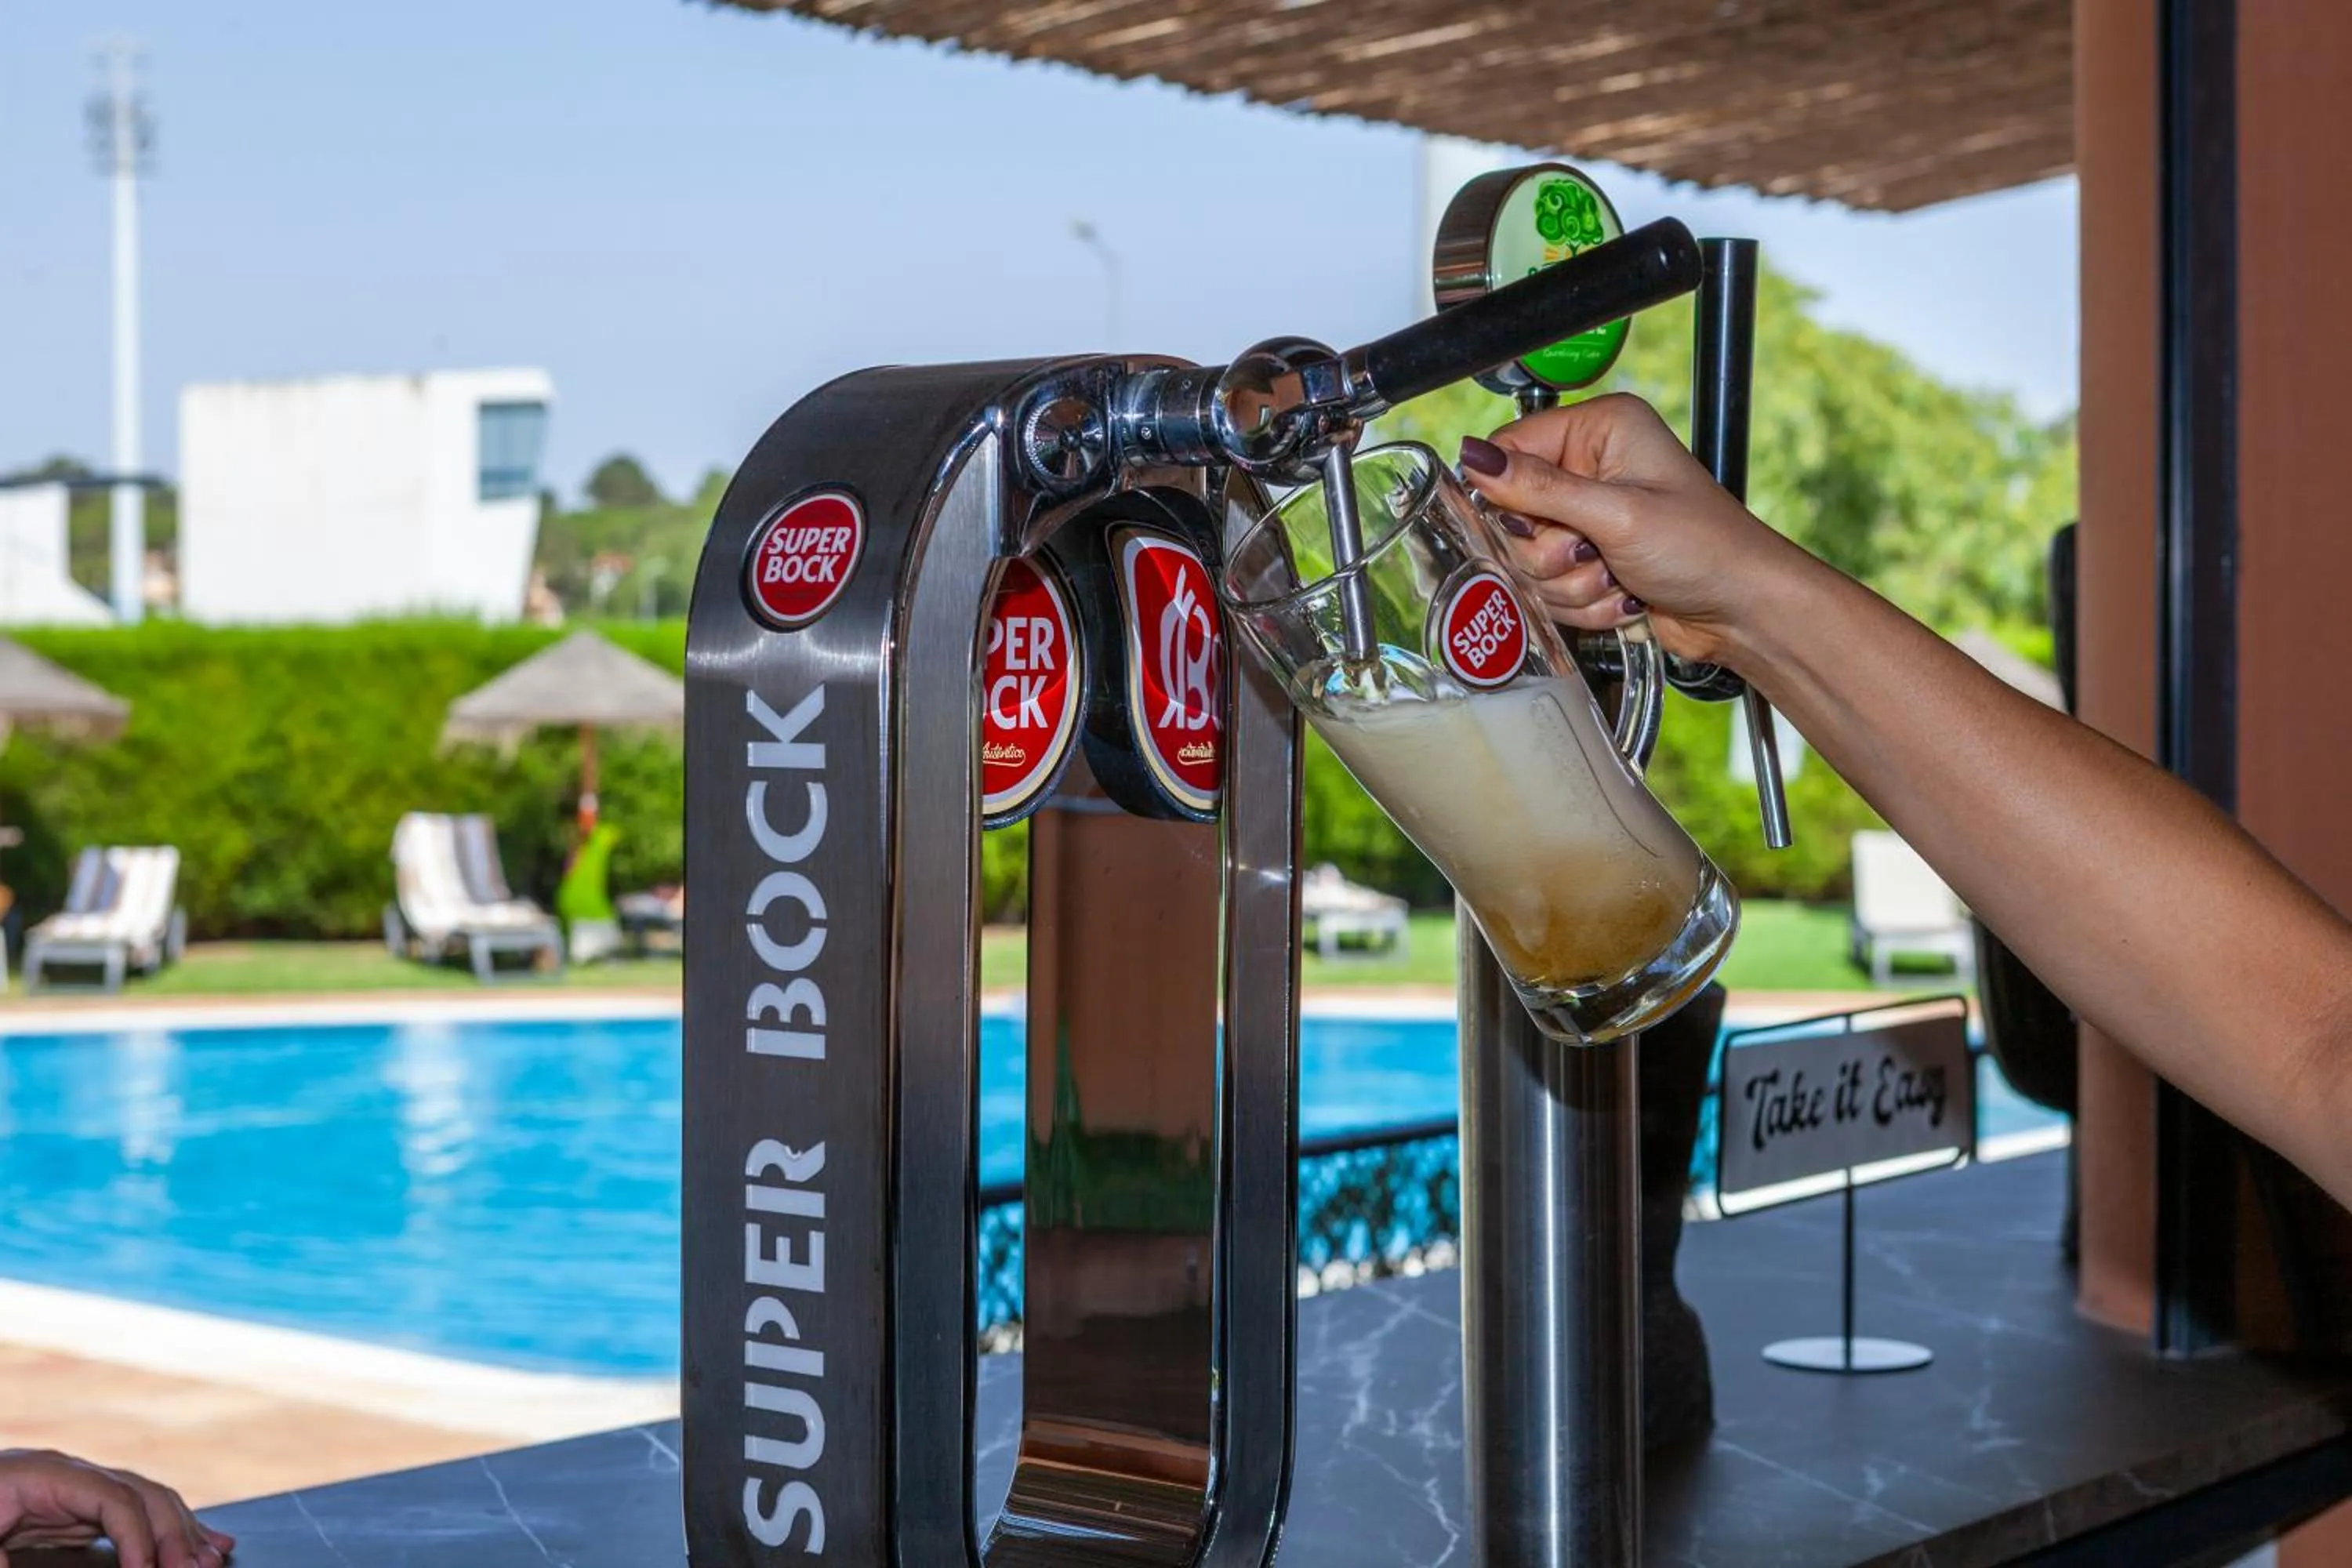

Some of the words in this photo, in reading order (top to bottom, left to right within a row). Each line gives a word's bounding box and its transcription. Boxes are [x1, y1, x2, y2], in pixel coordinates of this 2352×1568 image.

[763, 555, 840, 583] BOCK
[767, 527, 851, 554] SUPER
[985, 617, 1055, 670] PER
[1453, 590, 1507, 655] SUPER
[1467, 609, 1517, 669] BOCK
[983, 675, 1049, 730] CK
[746, 683, 828, 1060] BOCK
[1745, 1067, 1824, 1151] Take
[1835, 1059, 1864, 1124] it
[1871, 1056, 1946, 1129] Easy
[743, 1138, 826, 1555] SUPER
